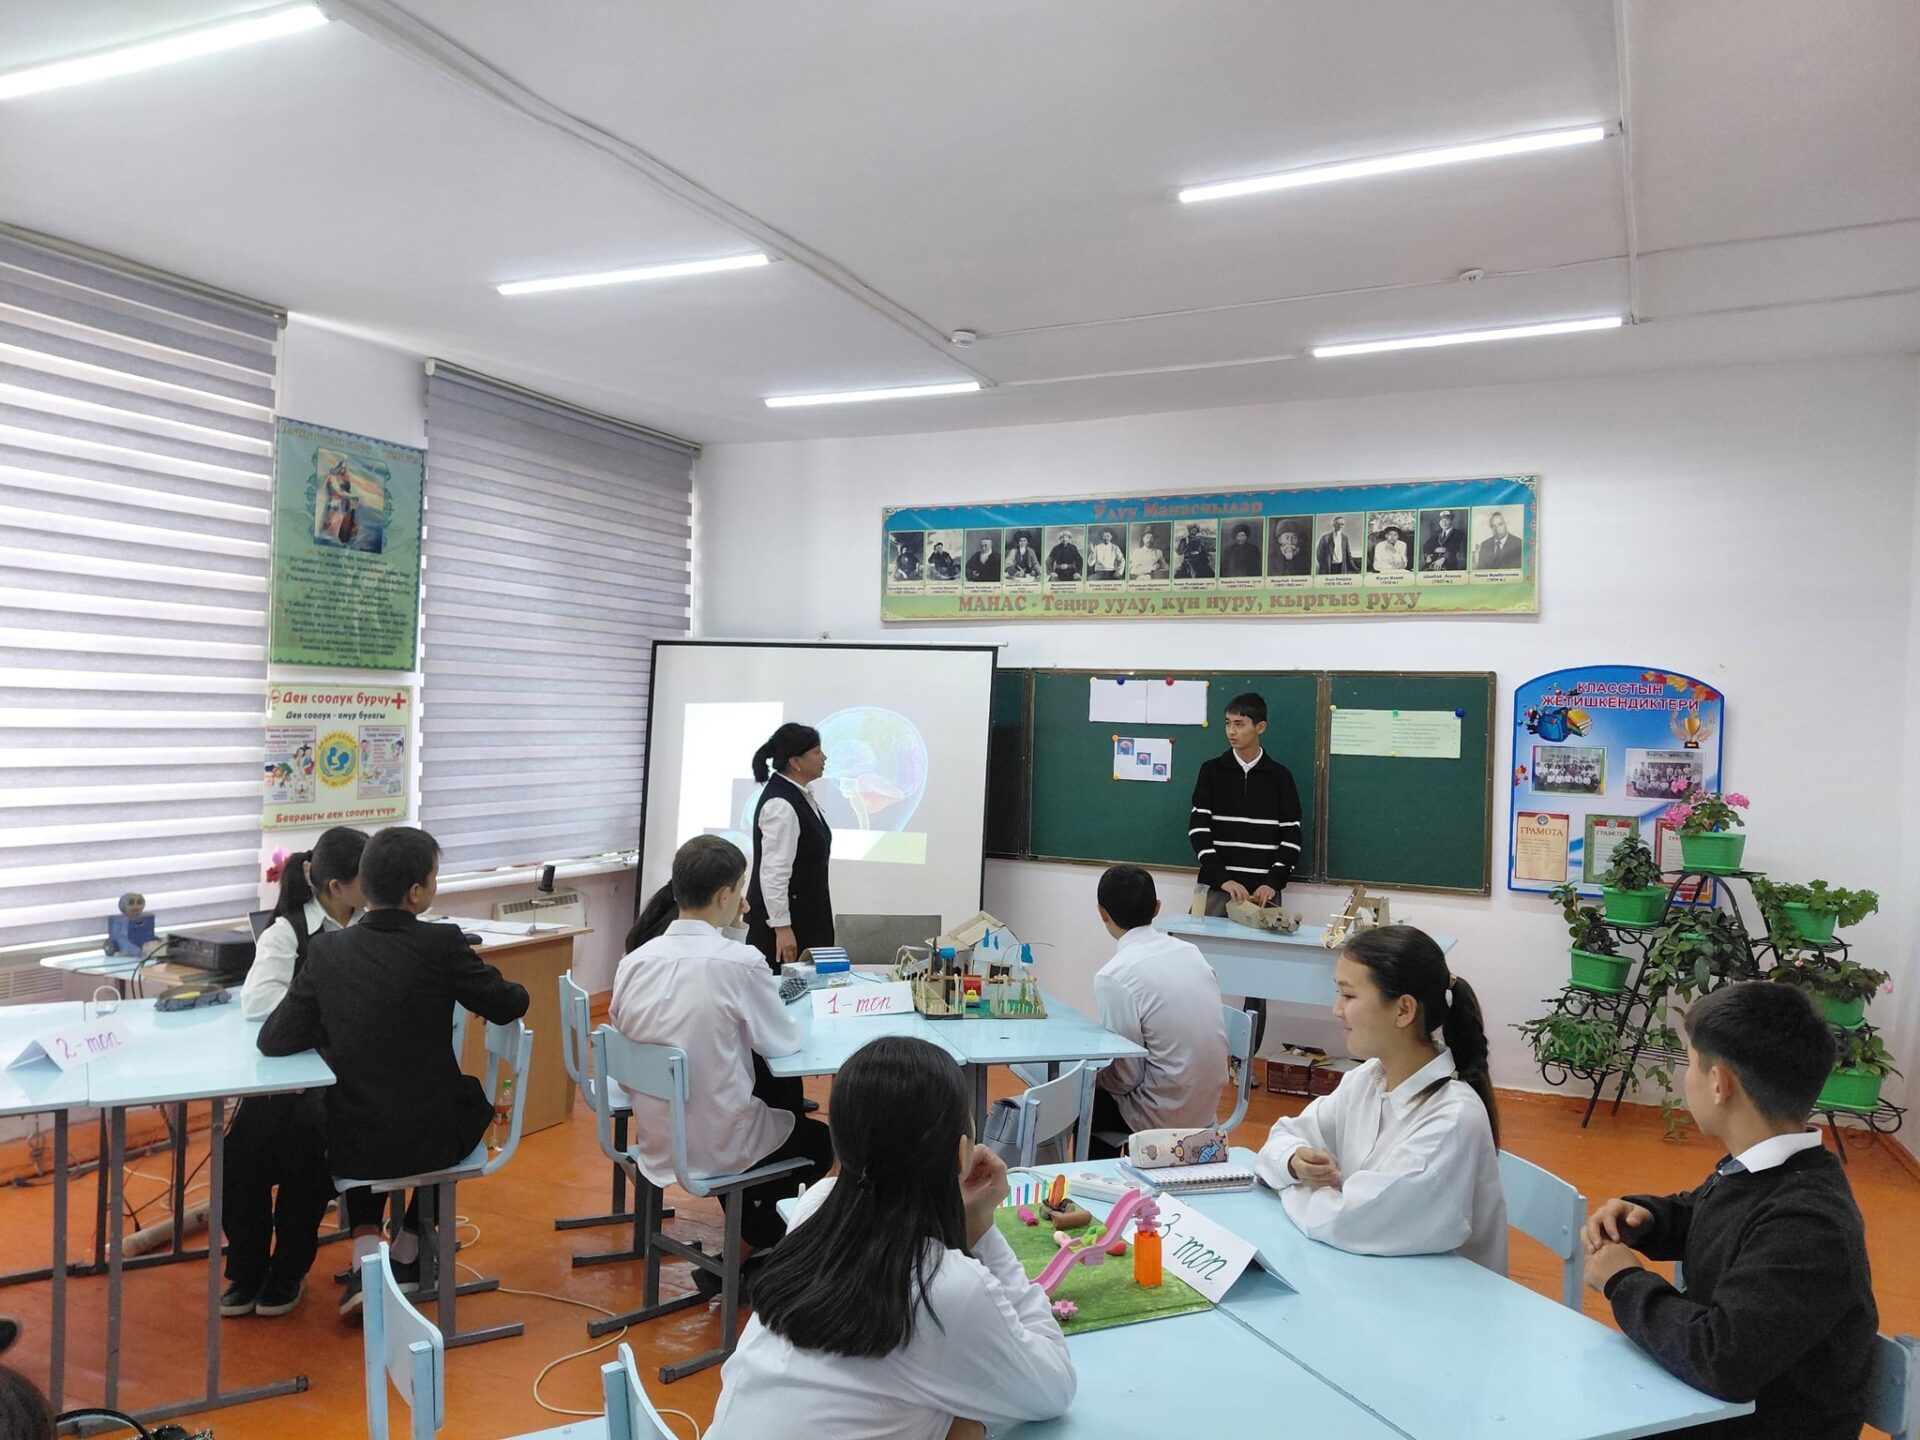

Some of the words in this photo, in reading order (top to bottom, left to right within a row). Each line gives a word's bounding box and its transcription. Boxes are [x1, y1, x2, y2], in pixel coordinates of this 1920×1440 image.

[958, 595, 1027, 611] МАНАС
[1042, 594, 1100, 613] Теңир
[1161, 596, 1201, 613] күн
[1206, 595, 1263, 612] нуру,
[1270, 593, 1360, 611] кыргыз
[1366, 592, 1423, 610] руху
[1576, 682, 1664, 696] КЛАССТЫН
[282, 691, 308, 704] Ден
[312, 693, 353, 707] соолук
[356, 692, 392, 707] бурчу
[1542, 695, 1700, 711] ЖЕТИШКЕНДИКТЕРИ
[285, 711, 302, 720] Ден
[304, 712, 332, 721] соолук
[327, 810, 344, 820] ден
[345, 808, 375, 819] соолук
[1520, 826, 1564, 837] ГРАМОТА
[1596, 829, 1628, 838] ГРАМОТА
